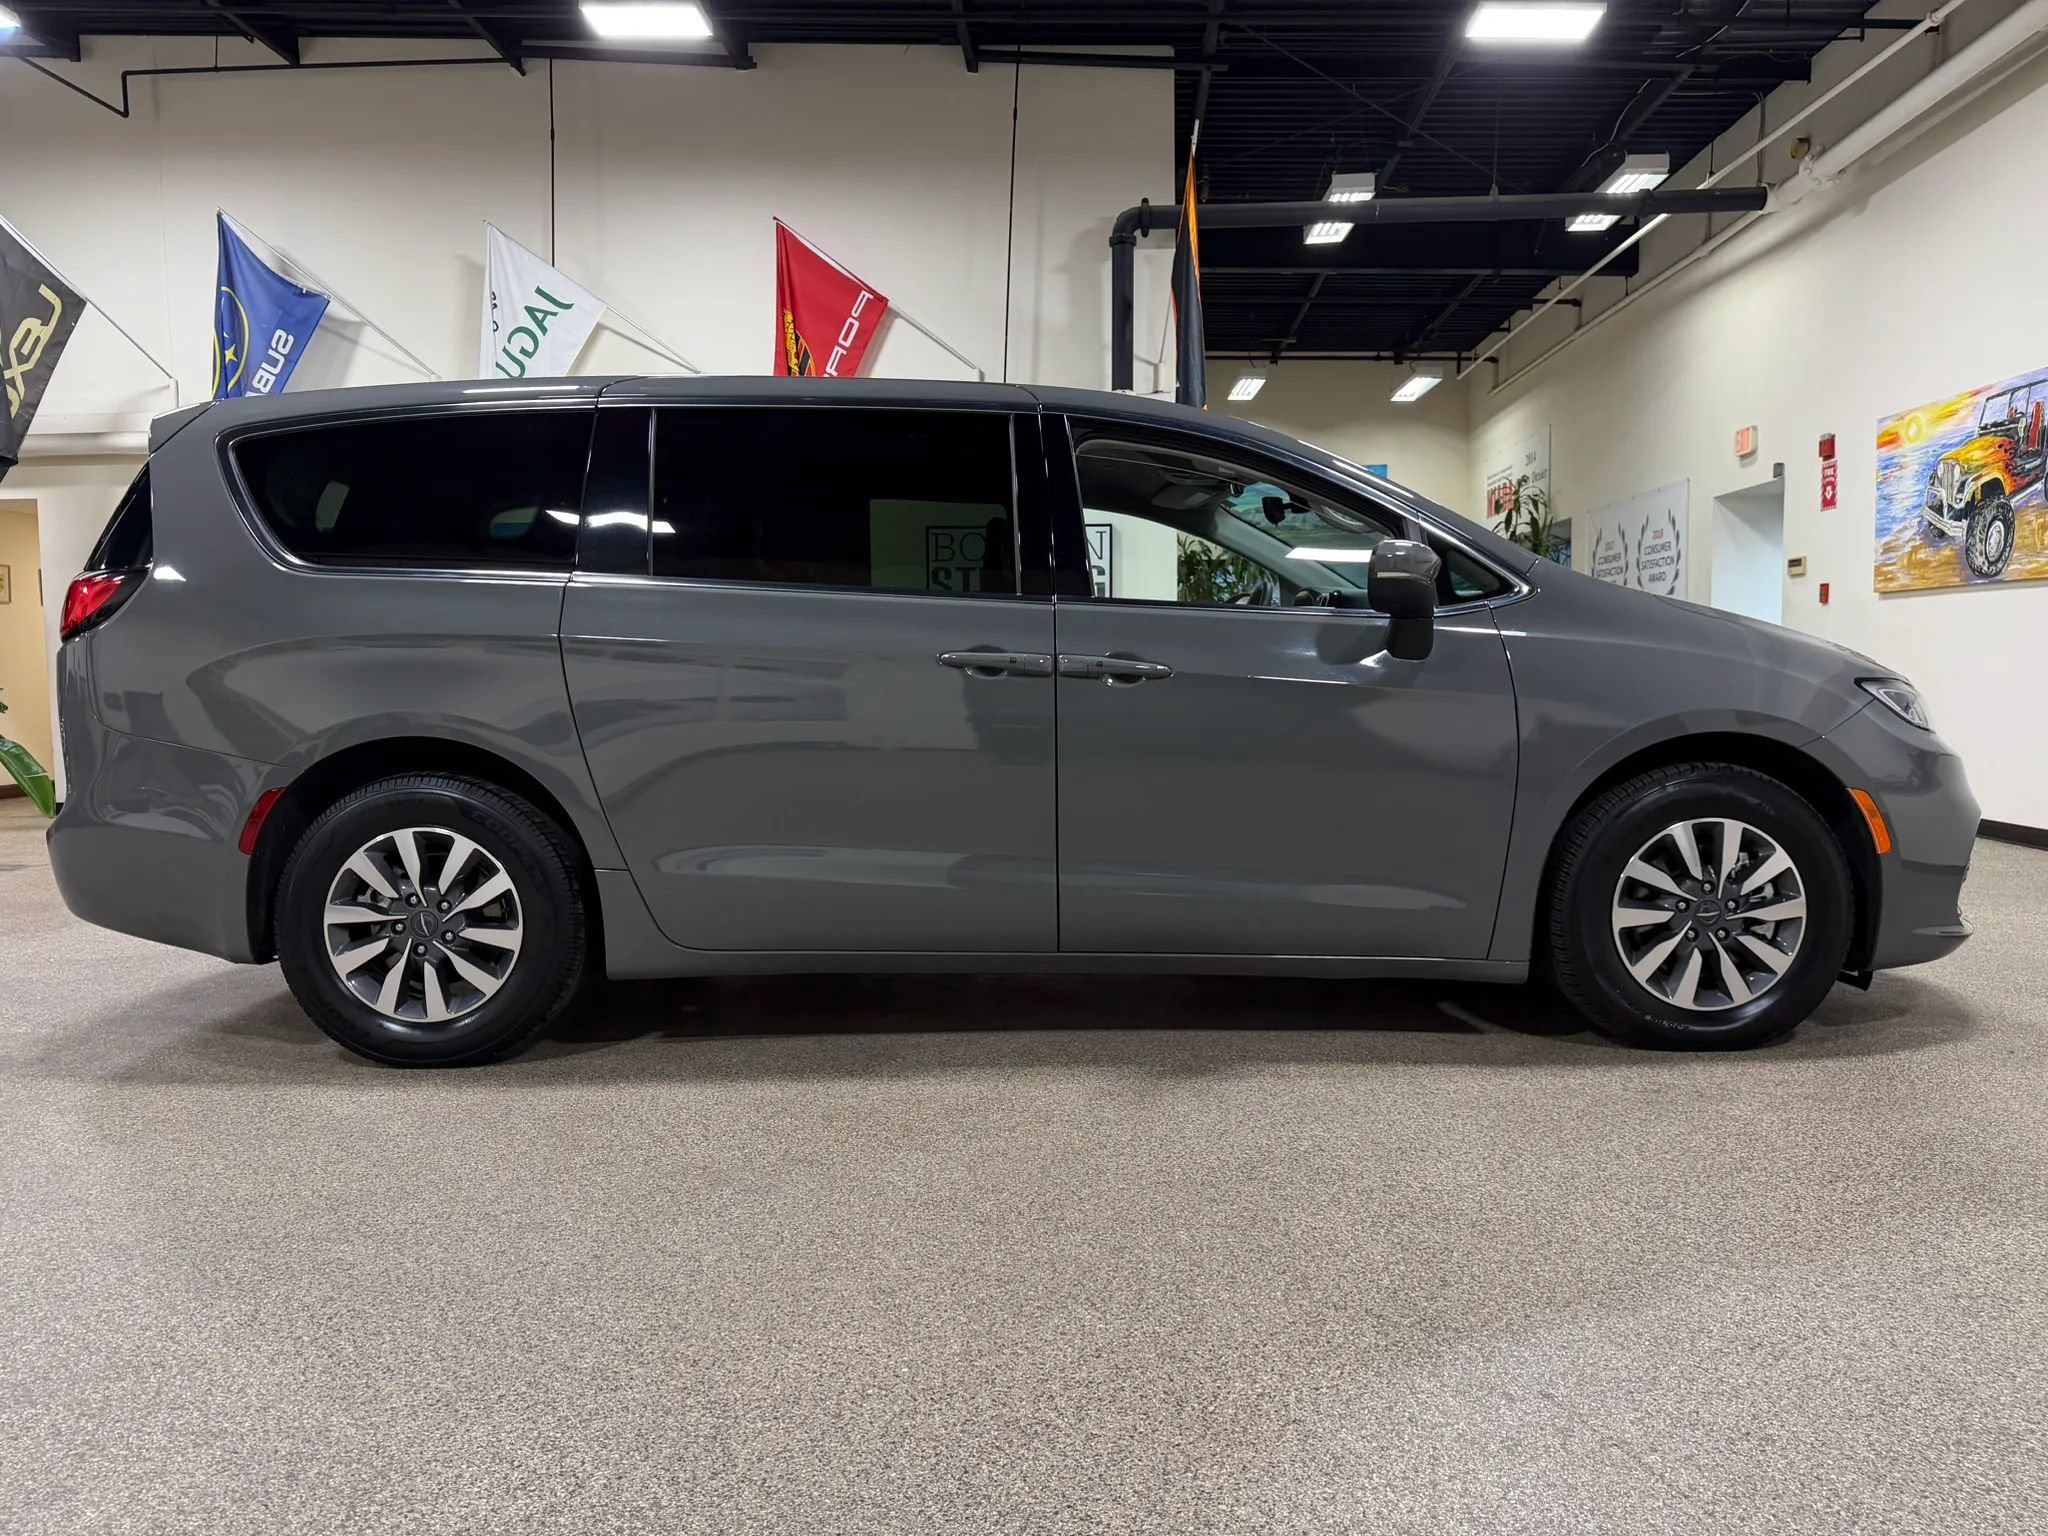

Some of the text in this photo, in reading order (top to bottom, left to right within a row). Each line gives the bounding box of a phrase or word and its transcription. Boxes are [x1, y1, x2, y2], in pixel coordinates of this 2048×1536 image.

[1644, 541, 1672, 556] CONSUMER
[1597, 552, 1622, 566] CONSUMER
[1640, 556, 1675, 571] SATISFACTION
[1648, 571, 1667, 583] AWARD
